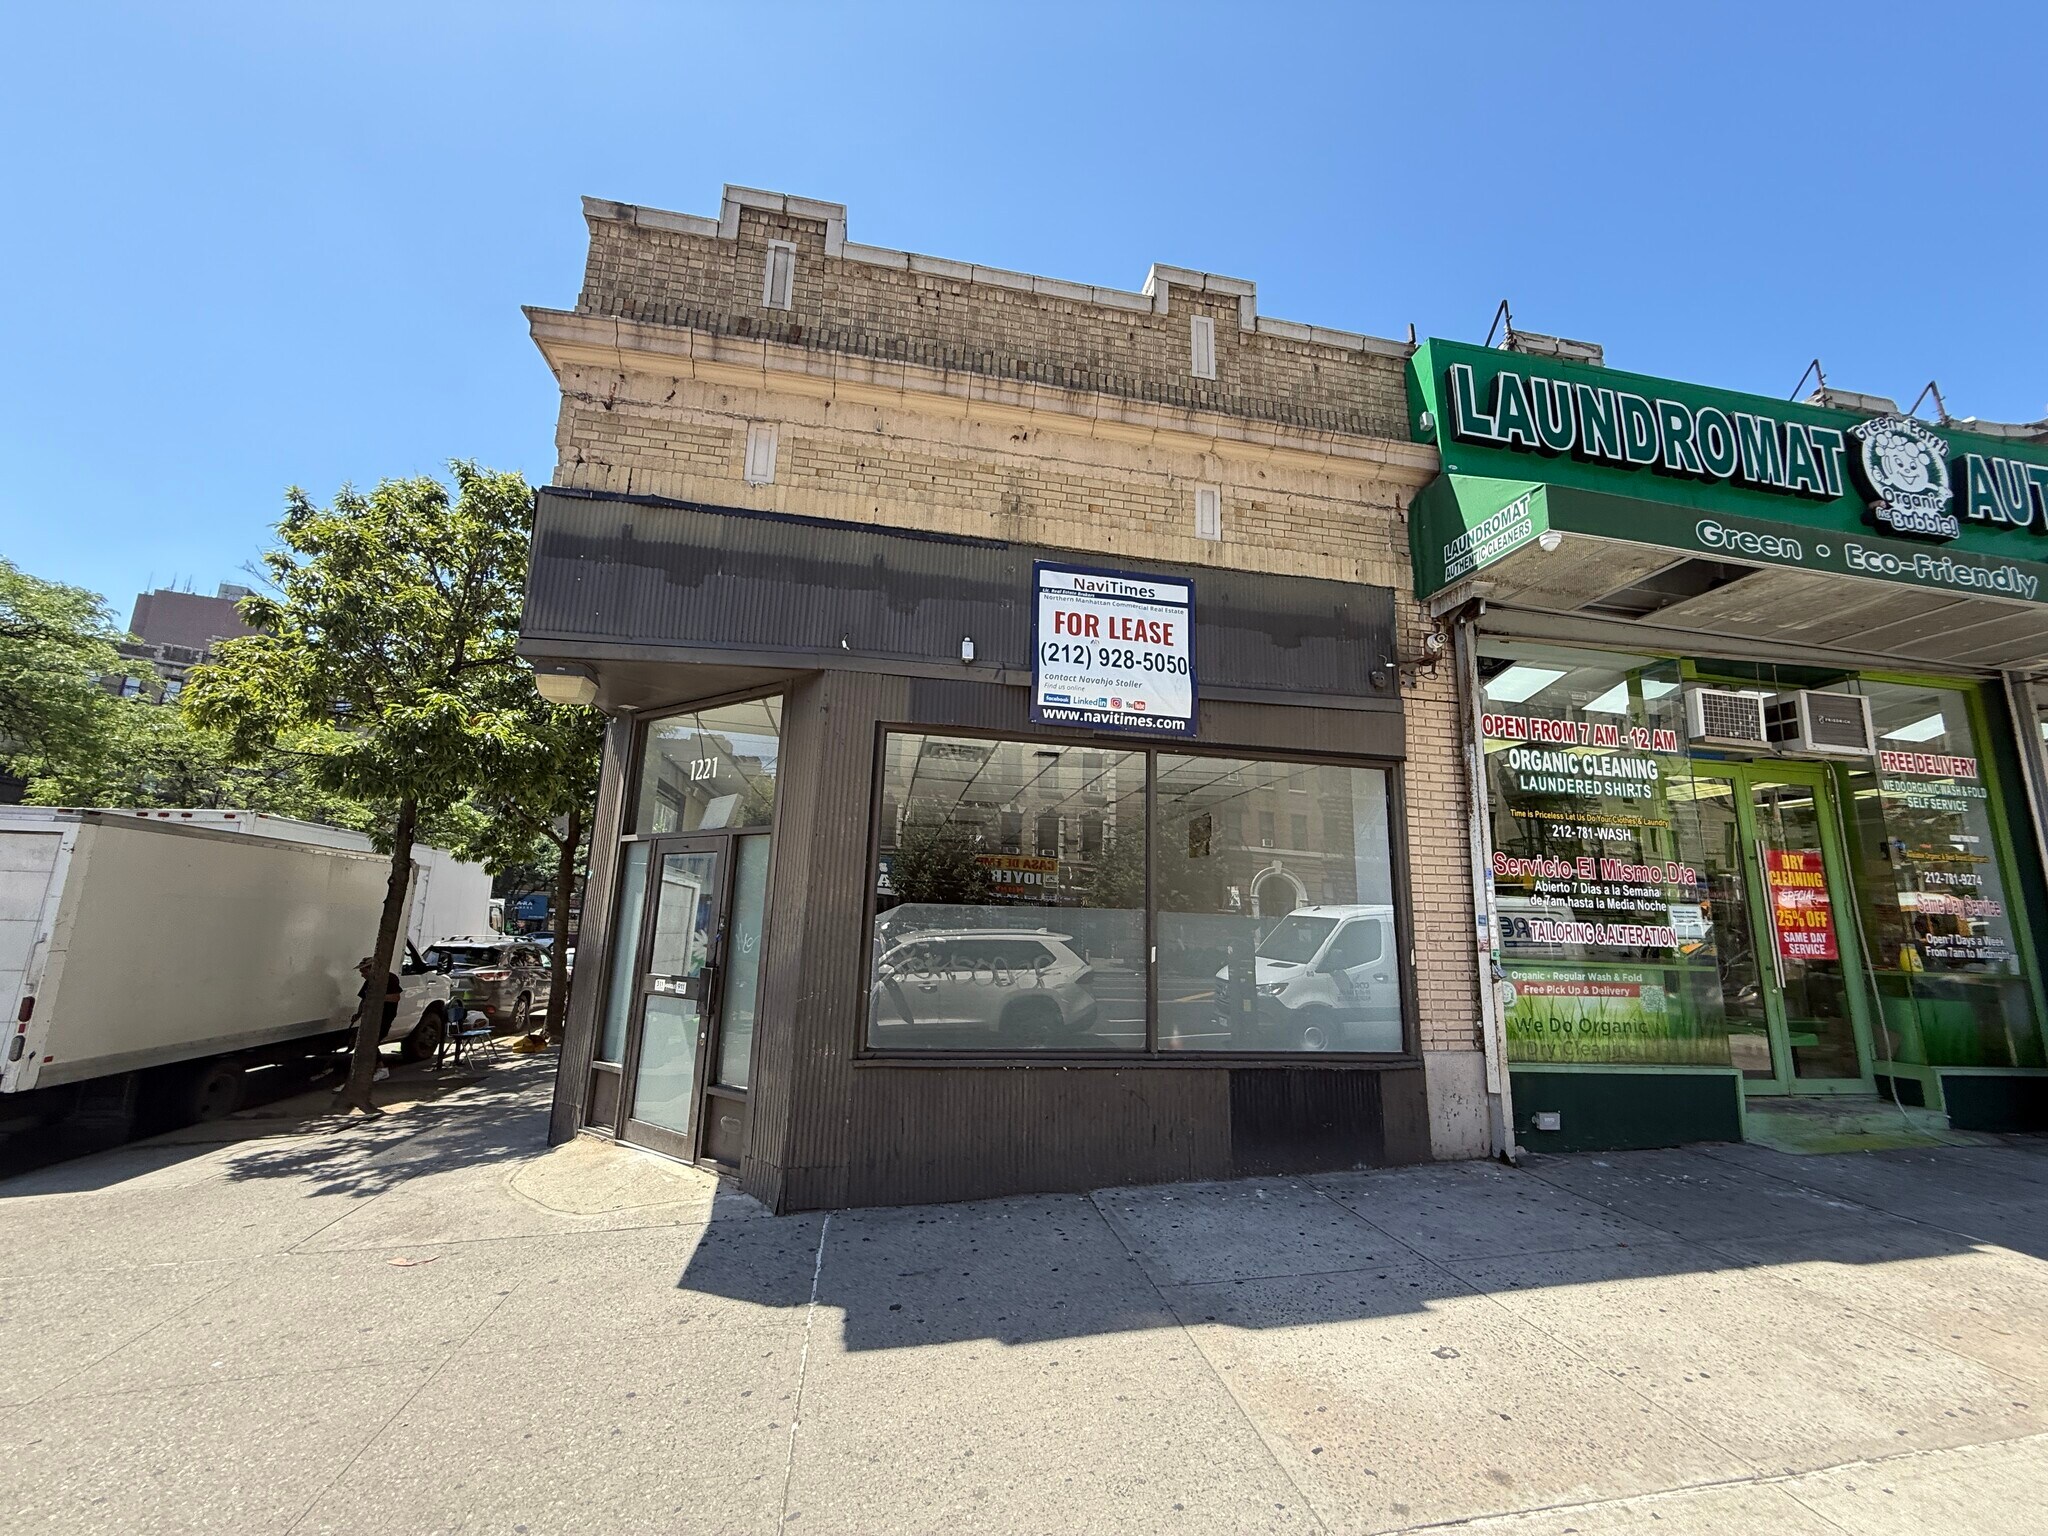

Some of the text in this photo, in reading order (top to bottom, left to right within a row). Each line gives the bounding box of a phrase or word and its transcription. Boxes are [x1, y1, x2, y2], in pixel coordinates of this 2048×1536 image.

[1452, 363, 1844, 497] LAUNDROMAT
[1852, 416, 1950, 456] Green Earth
[1883, 487, 1945, 511] Organic
[1444, 493, 1530, 563] LAUNDROMAT
[1891, 510, 1960, 538] Bubble!
[1445, 519, 1531, 582] AUTHENTIC CLEANERS
[1695, 519, 2038, 599] Green Eco-Friendly
[1073, 577, 1155, 598] NaviTimes
[1043, 594, 1074, 603] Northern
[1075, 597, 1111, 606] Manhattan
[1112, 601, 1149, 611] Commercial
[1054, 610, 1174, 646] FOR LEASE
[1041, 642, 1187, 675] (212) 928-5050
[1044, 673, 1077, 682] contact
[1115, 679, 1143, 689] Stoller
[1043, 708, 1185, 730] www.navitimes.com
[1482, 714, 1529, 739] OPEN
[1530, 718, 1577, 744] FROM
[1579, 723, 1590, 744] 7
[1594, 725, 1618, 747] AM
[1630, 727, 1650, 750] 12
[1653, 730, 1677, 752] AM
[690, 757, 718, 781] 1221
[1509, 749, 1658, 780] ORGANIC CLEANING
[1879, 750, 1977, 778] FREE DELIVERY
[1520, 776, 1652, 798] LAUNDERED SHIRTS
[1882, 779, 1894, 791] WE
[1895, 781, 1906, 792] DO
[1906, 782, 1939, 795] ORGANIC
[1940, 785, 1962, 797] WASH
[1968, 786, 1987, 798] FOLD
[1907, 796, 1968, 812] SELF SERVICE
[1510, 809, 1526, 818] Time
[1534, 810, 1564, 820] Priceless
[1565, 813, 1576, 821] Let
[1577, 813, 1585, 821] Us
[1586, 814, 1596, 822] Do
[1596, 814, 1611, 823] Your
[1643, 818, 1669, 828] Laundry
[1552, 825, 1631, 841] 212-781-WASH
[1493, 852, 1696, 885] Servicio El Mismo Dia
[1781, 854, 1804, 870] DRY
[1534, 880, 1570, 894] Abierto
[1572, 882, 1577, 893] 7
[1580, 883, 1602, 895] Dias
[1603, 886, 1610, 895] a
[1612, 884, 1621, 896] la
[1769, 871, 1824, 888] CLEANING
[1924, 872, 1983, 886] 212-781-9274
[1530, 895, 1666, 912] de 7am hasta la Media Noche
[1781, 889, 1817, 901] SPECIAL
[1916, 892, 2001, 920] Same Day Service
[1776, 910, 1827, 928] 25% OFF
[1529, 920, 1678, 947] TAILORING & ALTERATION
[1784, 932, 1827, 943] SAME DAY
[1926, 933, 1947, 946] Open
[1956, 934, 1976, 947] Days
[1983, 936, 2004, 947] Week
[1789, 944, 1826, 955] SERVICE
[1925, 946, 1947, 957] From
[1949, 947, 1966, 957] 7am
[1967, 949, 1975, 958] to
[1511, 971, 1643, 982] Organic Regular Wash & Fold
[1524, 985, 1630, 997] Free Pick Up & Delivery
[1515, 1017, 1649, 1036] We Do Organic
